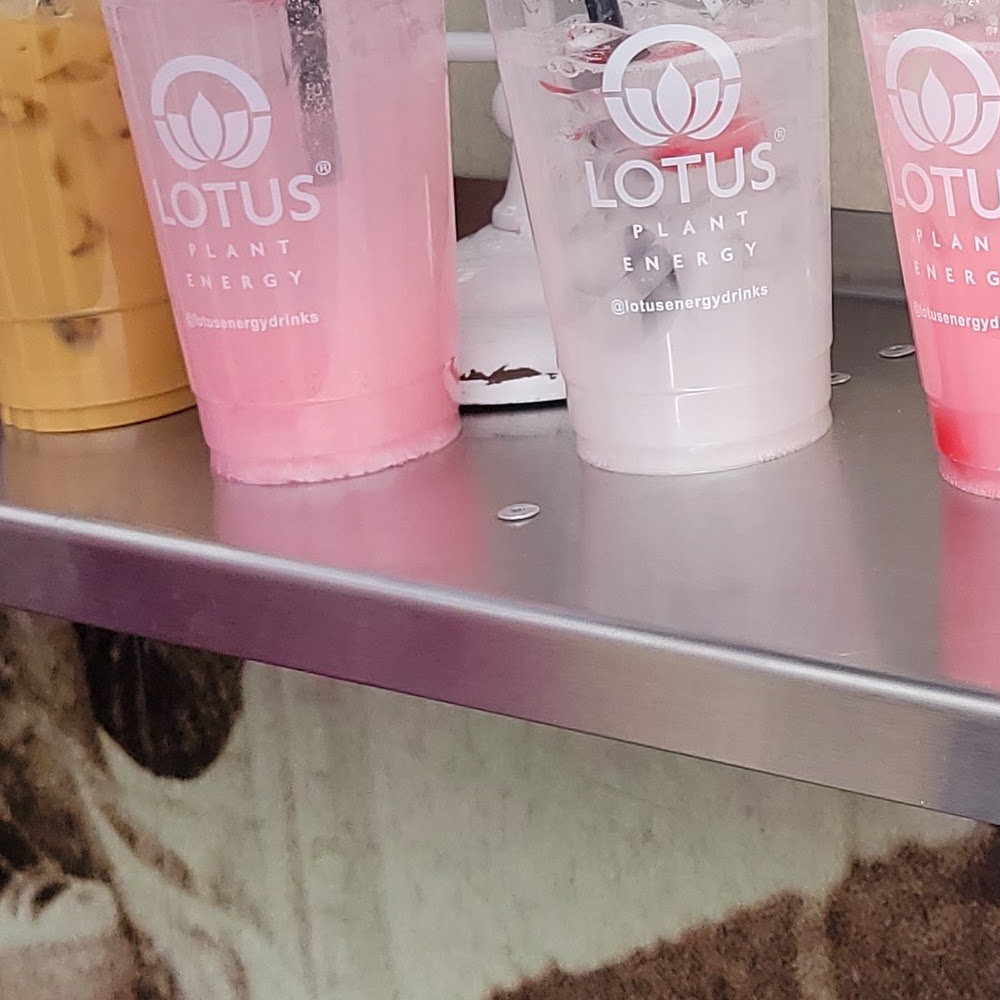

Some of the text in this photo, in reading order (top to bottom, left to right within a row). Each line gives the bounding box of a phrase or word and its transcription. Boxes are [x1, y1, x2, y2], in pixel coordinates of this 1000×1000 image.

[632, 211, 749, 239] PLANT
[189, 239, 290, 259] PLANT
[623, 242, 757, 272] ENERGY
[186, 270, 303, 290] ENERGY
[611, 284, 769, 315] @lotusenergydrinks
